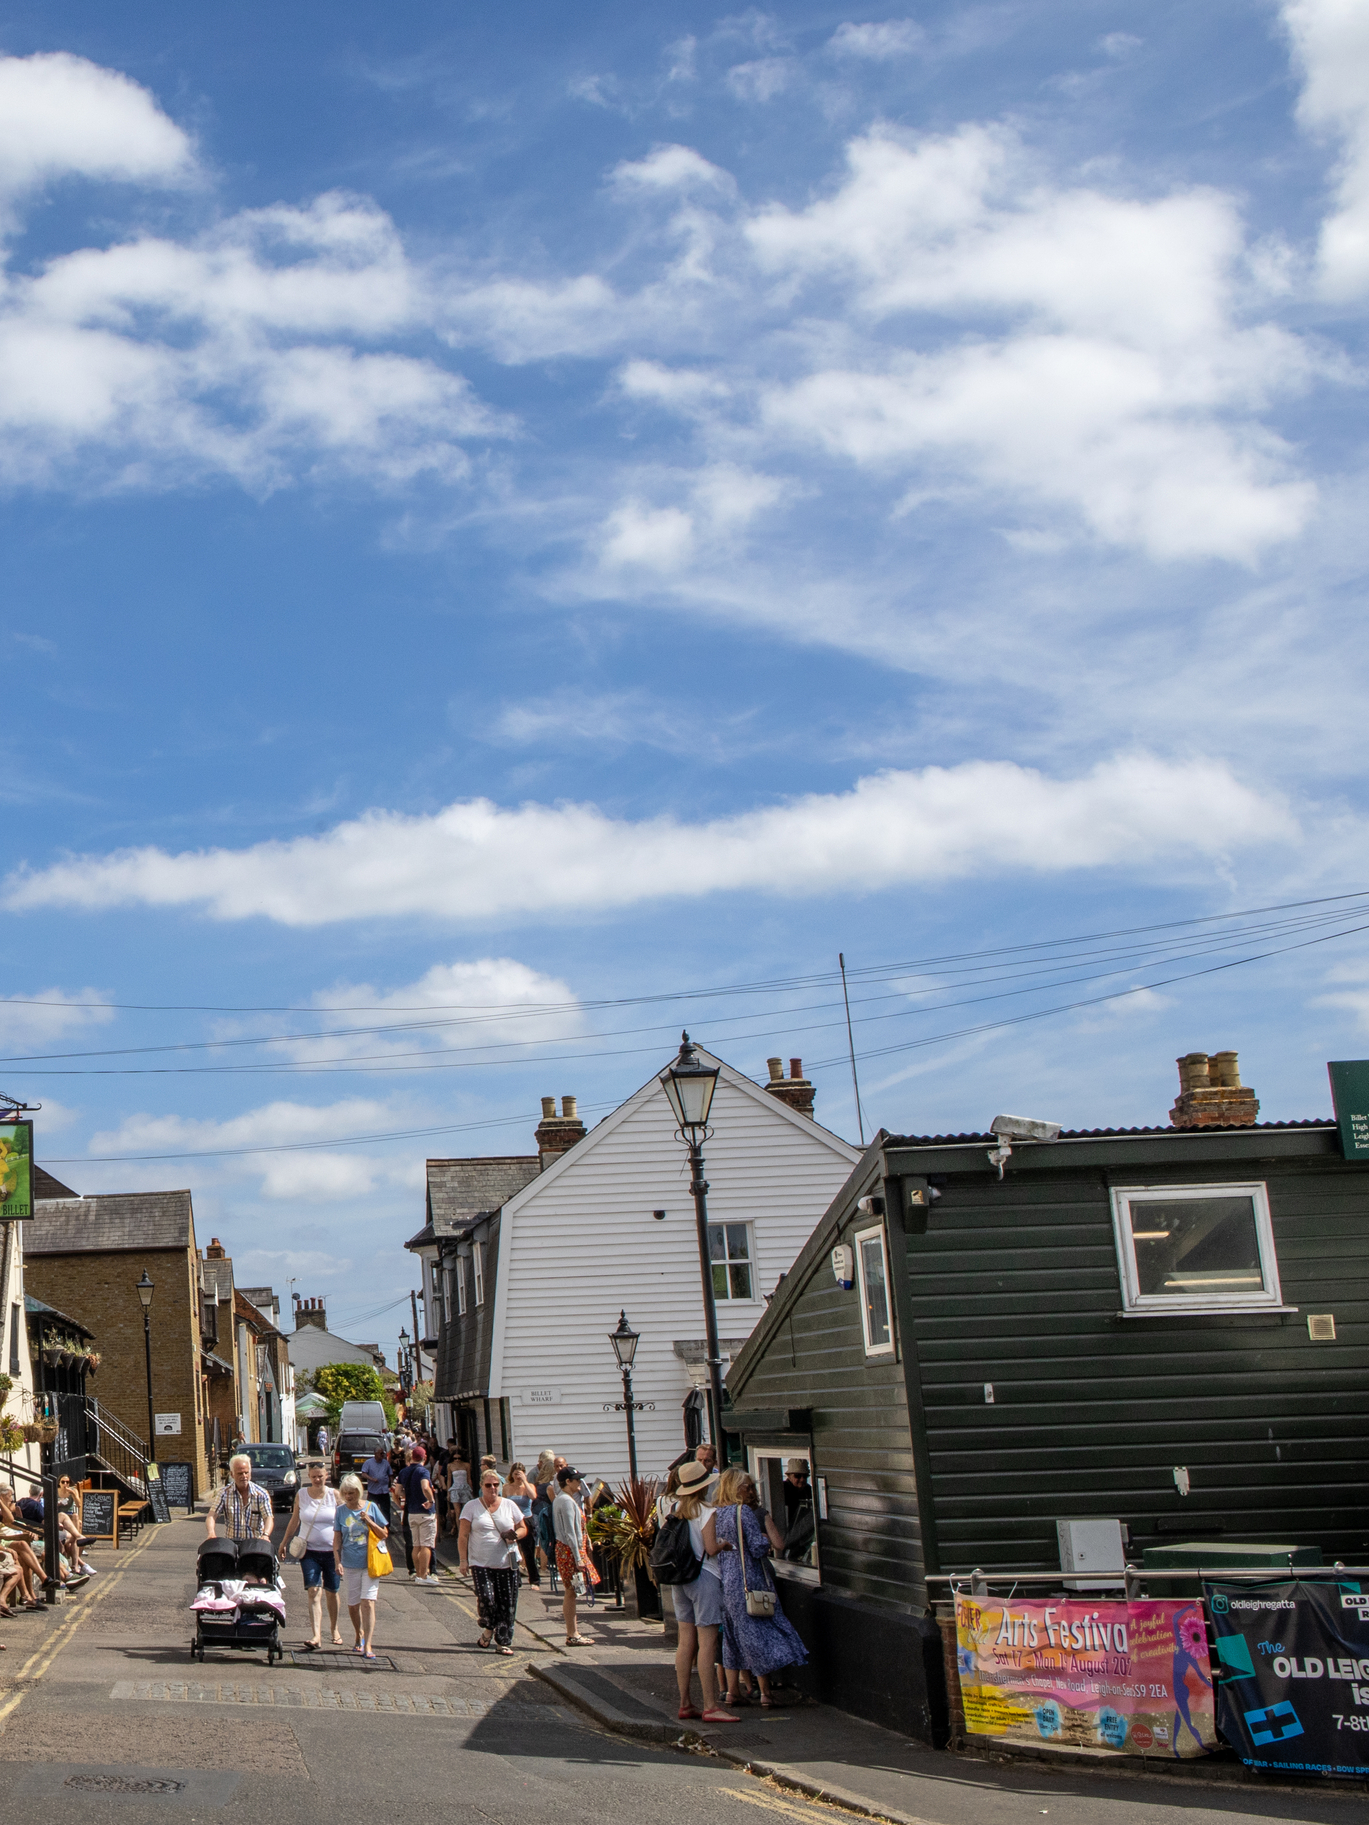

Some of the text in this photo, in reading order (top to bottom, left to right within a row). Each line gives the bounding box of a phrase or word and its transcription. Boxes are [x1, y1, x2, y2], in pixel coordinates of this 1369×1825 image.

[1352, 1124, 1368, 1132] High
[2, 1203, 29, 1215] BILLET
[1231, 1599, 1296, 1611] oldleighregatta
[1345, 1597, 1367, 1605] OLD
[1130, 1612, 1165, 1631] A joyful
[995, 1607, 1128, 1653] Arts Festiva
[1140, 1642, 1180, 1659] creativity
[1257, 1640, 1285, 1655] The
[993, 1648, 1010, 1666] Sat
[1012, 1651, 1023, 1668] 17
[1033, 1651, 1055, 1670] Mon
[1069, 1653, 1109, 1678] August
[1111, 1656, 1132, 1677] 202
[1273, 1656, 1324, 1679] OLD
[1030, 1673, 1055, 1690] Chapel,
[1149, 1684, 1168, 1699] 2EA
[1042, 1708, 1055, 1716] OPEN
[1106, 1716, 1118, 1724] FREE
[1332, 1714, 1369, 1731] 7-8t
[1104, 1723, 1119, 1732] ENTRY
[1273, 1761, 1304, 1770] SAILING
[1305, 1763, 1332, 1771] RACES
[1337, 1765, 1354, 1773] BOW
